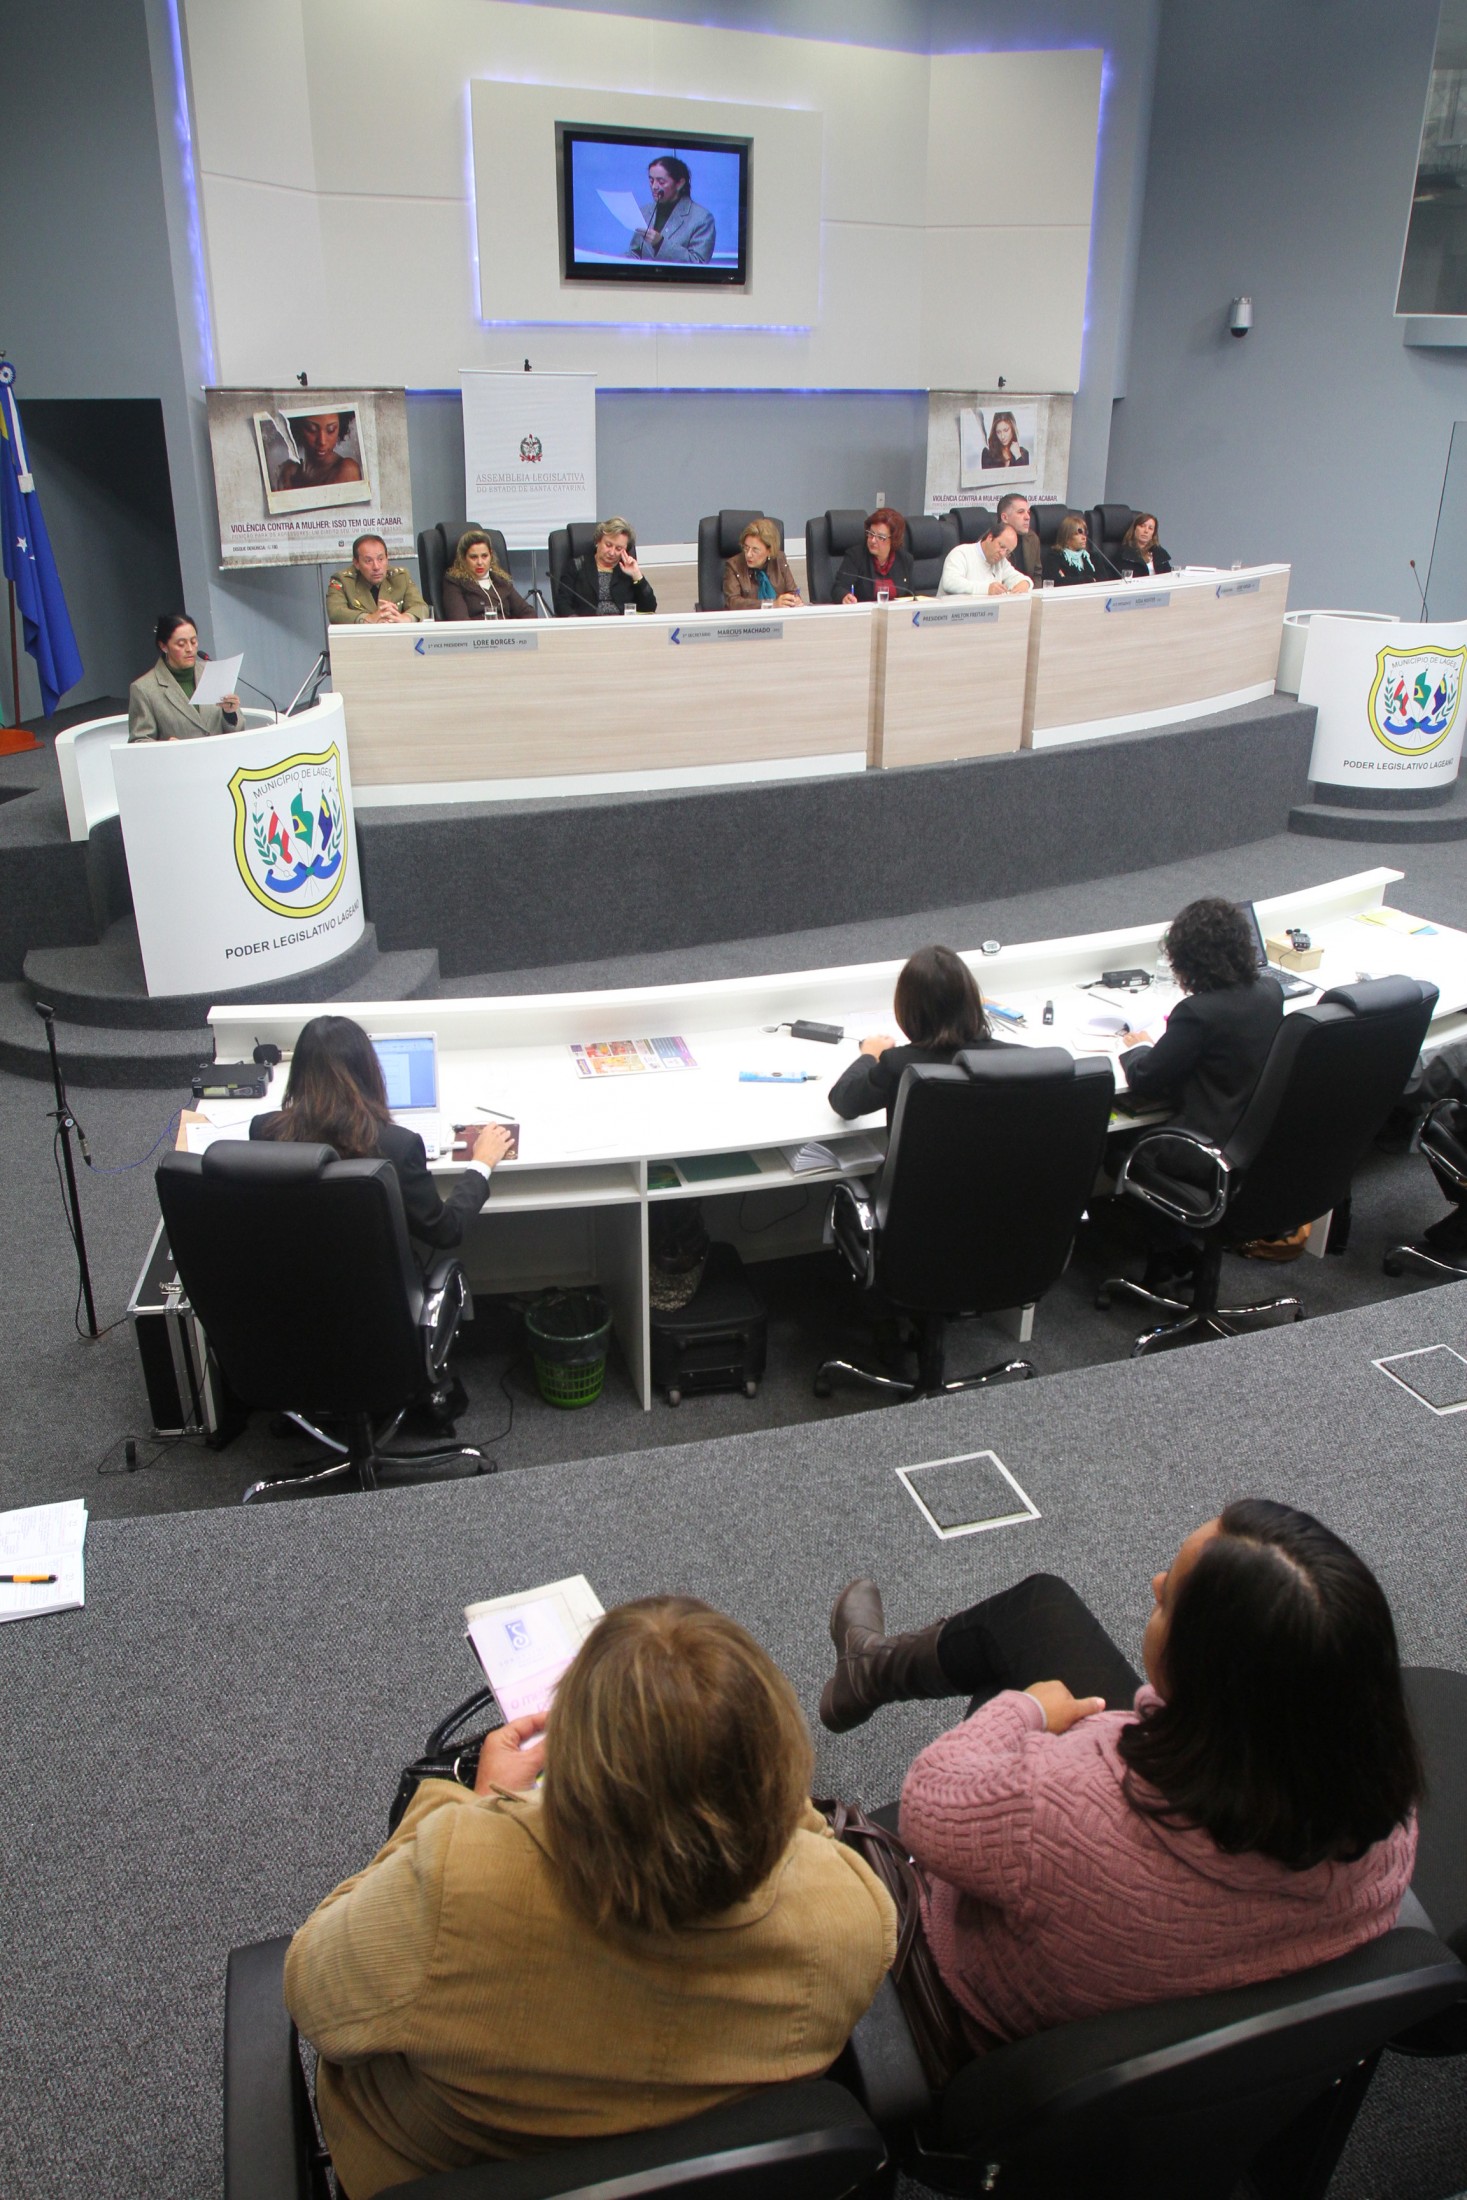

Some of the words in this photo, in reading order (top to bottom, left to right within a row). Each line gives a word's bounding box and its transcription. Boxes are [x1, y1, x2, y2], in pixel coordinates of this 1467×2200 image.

[476, 473, 530, 482] ASSEMBLEIA
[532, 472, 585, 482] LEGISLATIVA
[489, 485, 517, 493] ESTADO
[553, 484, 586, 492] CATARINA
[231, 522, 267, 533] VIOLÊNCIA
[267, 522, 295, 532] CONTRA
[295, 521, 301, 530] A
[301, 520, 331, 530] MULHER:
[331, 519, 347, 528] ISSO
[347, 518, 361, 527] TEM
[362, 518, 376, 527] QUE
[717, 628, 742, 636] MARCIUS
[1429, 656, 1439, 664] DE
[1439, 658, 1458, 669] LAGES
[1343, 759, 1375, 770] PODER
[1376, 762, 1429, 771] LEGISLATIVO
[252, 771, 300, 799] MUNICÍPIO
[300, 769, 312, 779] DE
[312, 767, 332, 778] LAGES
[225, 940, 271, 959] PODER
[273, 917, 336, 949] LEGISLATIVO
